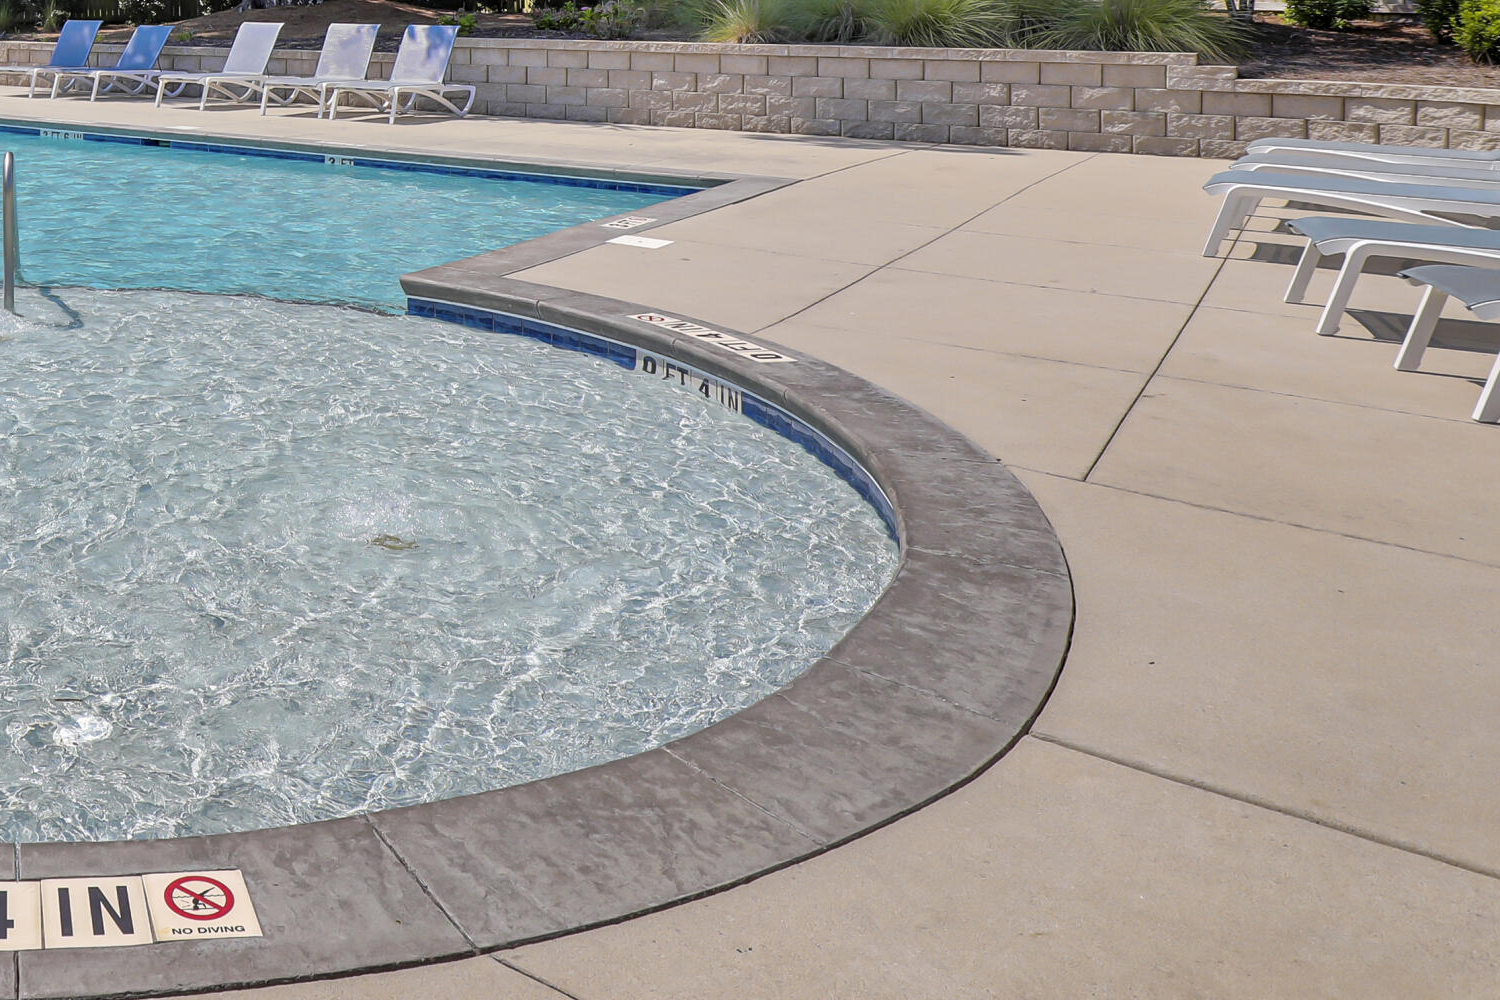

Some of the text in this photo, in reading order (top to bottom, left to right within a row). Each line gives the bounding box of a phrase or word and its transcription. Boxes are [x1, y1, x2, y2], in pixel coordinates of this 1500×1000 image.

[671, 323, 703, 331] IN
[718, 342, 762, 350] FT
[642, 355, 739, 412] 0 FT 4 IN
[57, 885, 136, 938] IN
[171, 924, 246, 936] NO DIVING
